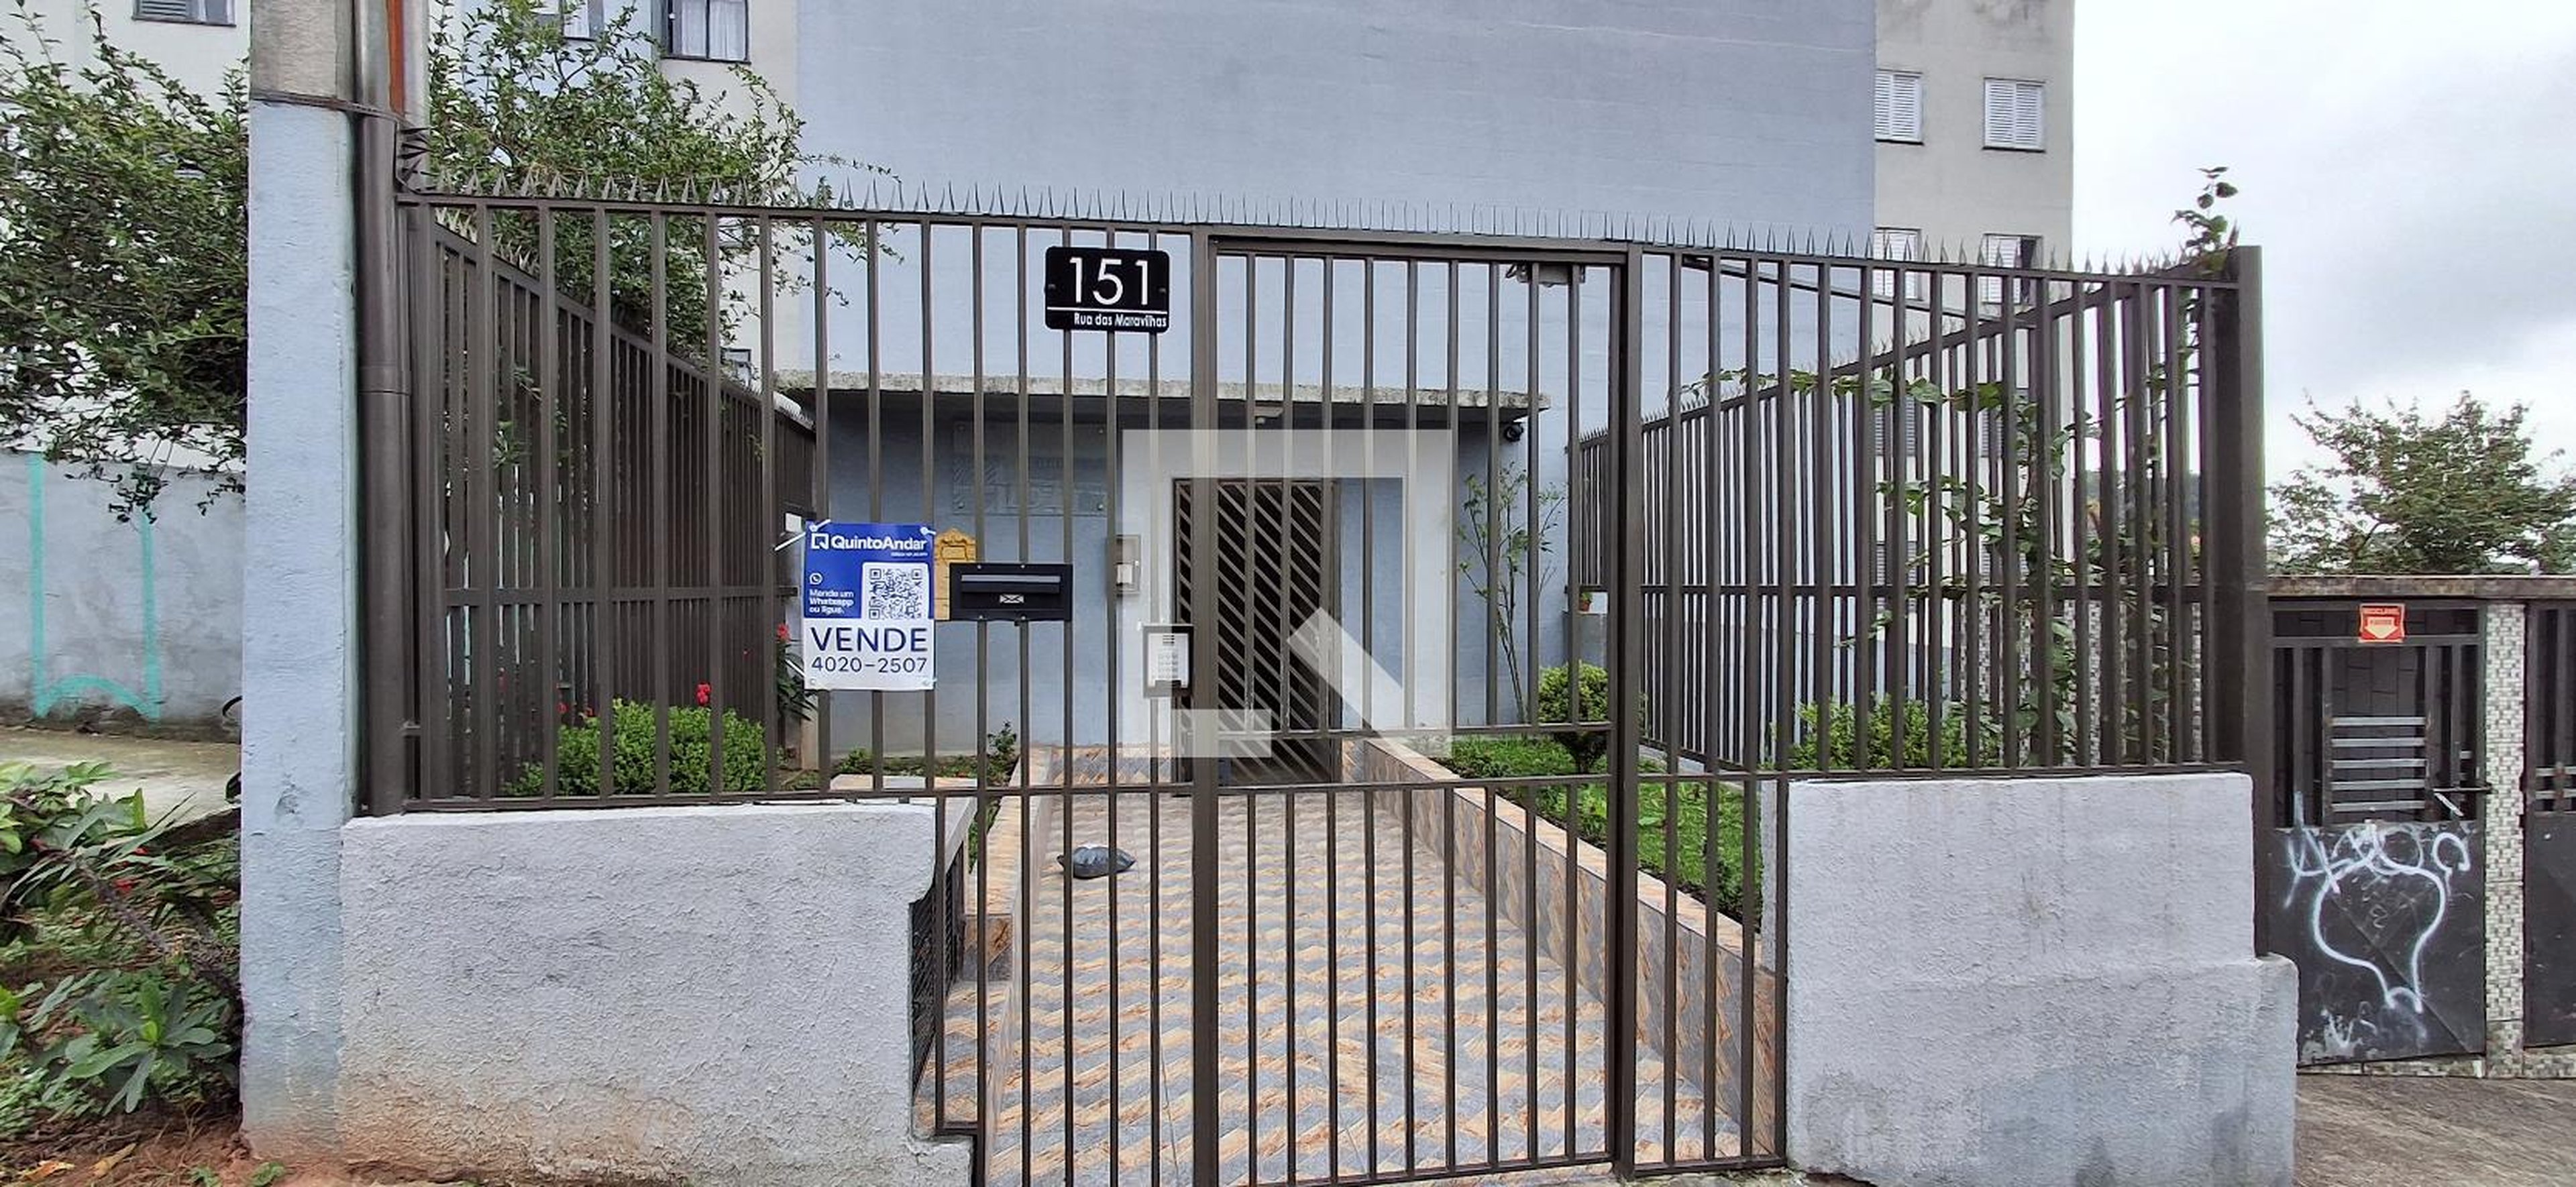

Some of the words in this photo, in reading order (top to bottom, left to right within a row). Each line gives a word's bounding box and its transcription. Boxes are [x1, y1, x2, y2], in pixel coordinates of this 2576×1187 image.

[1069, 257, 1148, 305] 151
[1074, 313, 1093, 325] Rua
[1095, 314, 1112, 326] das
[1114, 314, 1167, 327] Maravilhas
[831, 535, 928, 551] QuintoAndar
[810, 589, 839, 597] Mande
[810, 627, 928, 653] VENDE
[811, 656, 927, 673] 4020-2507
